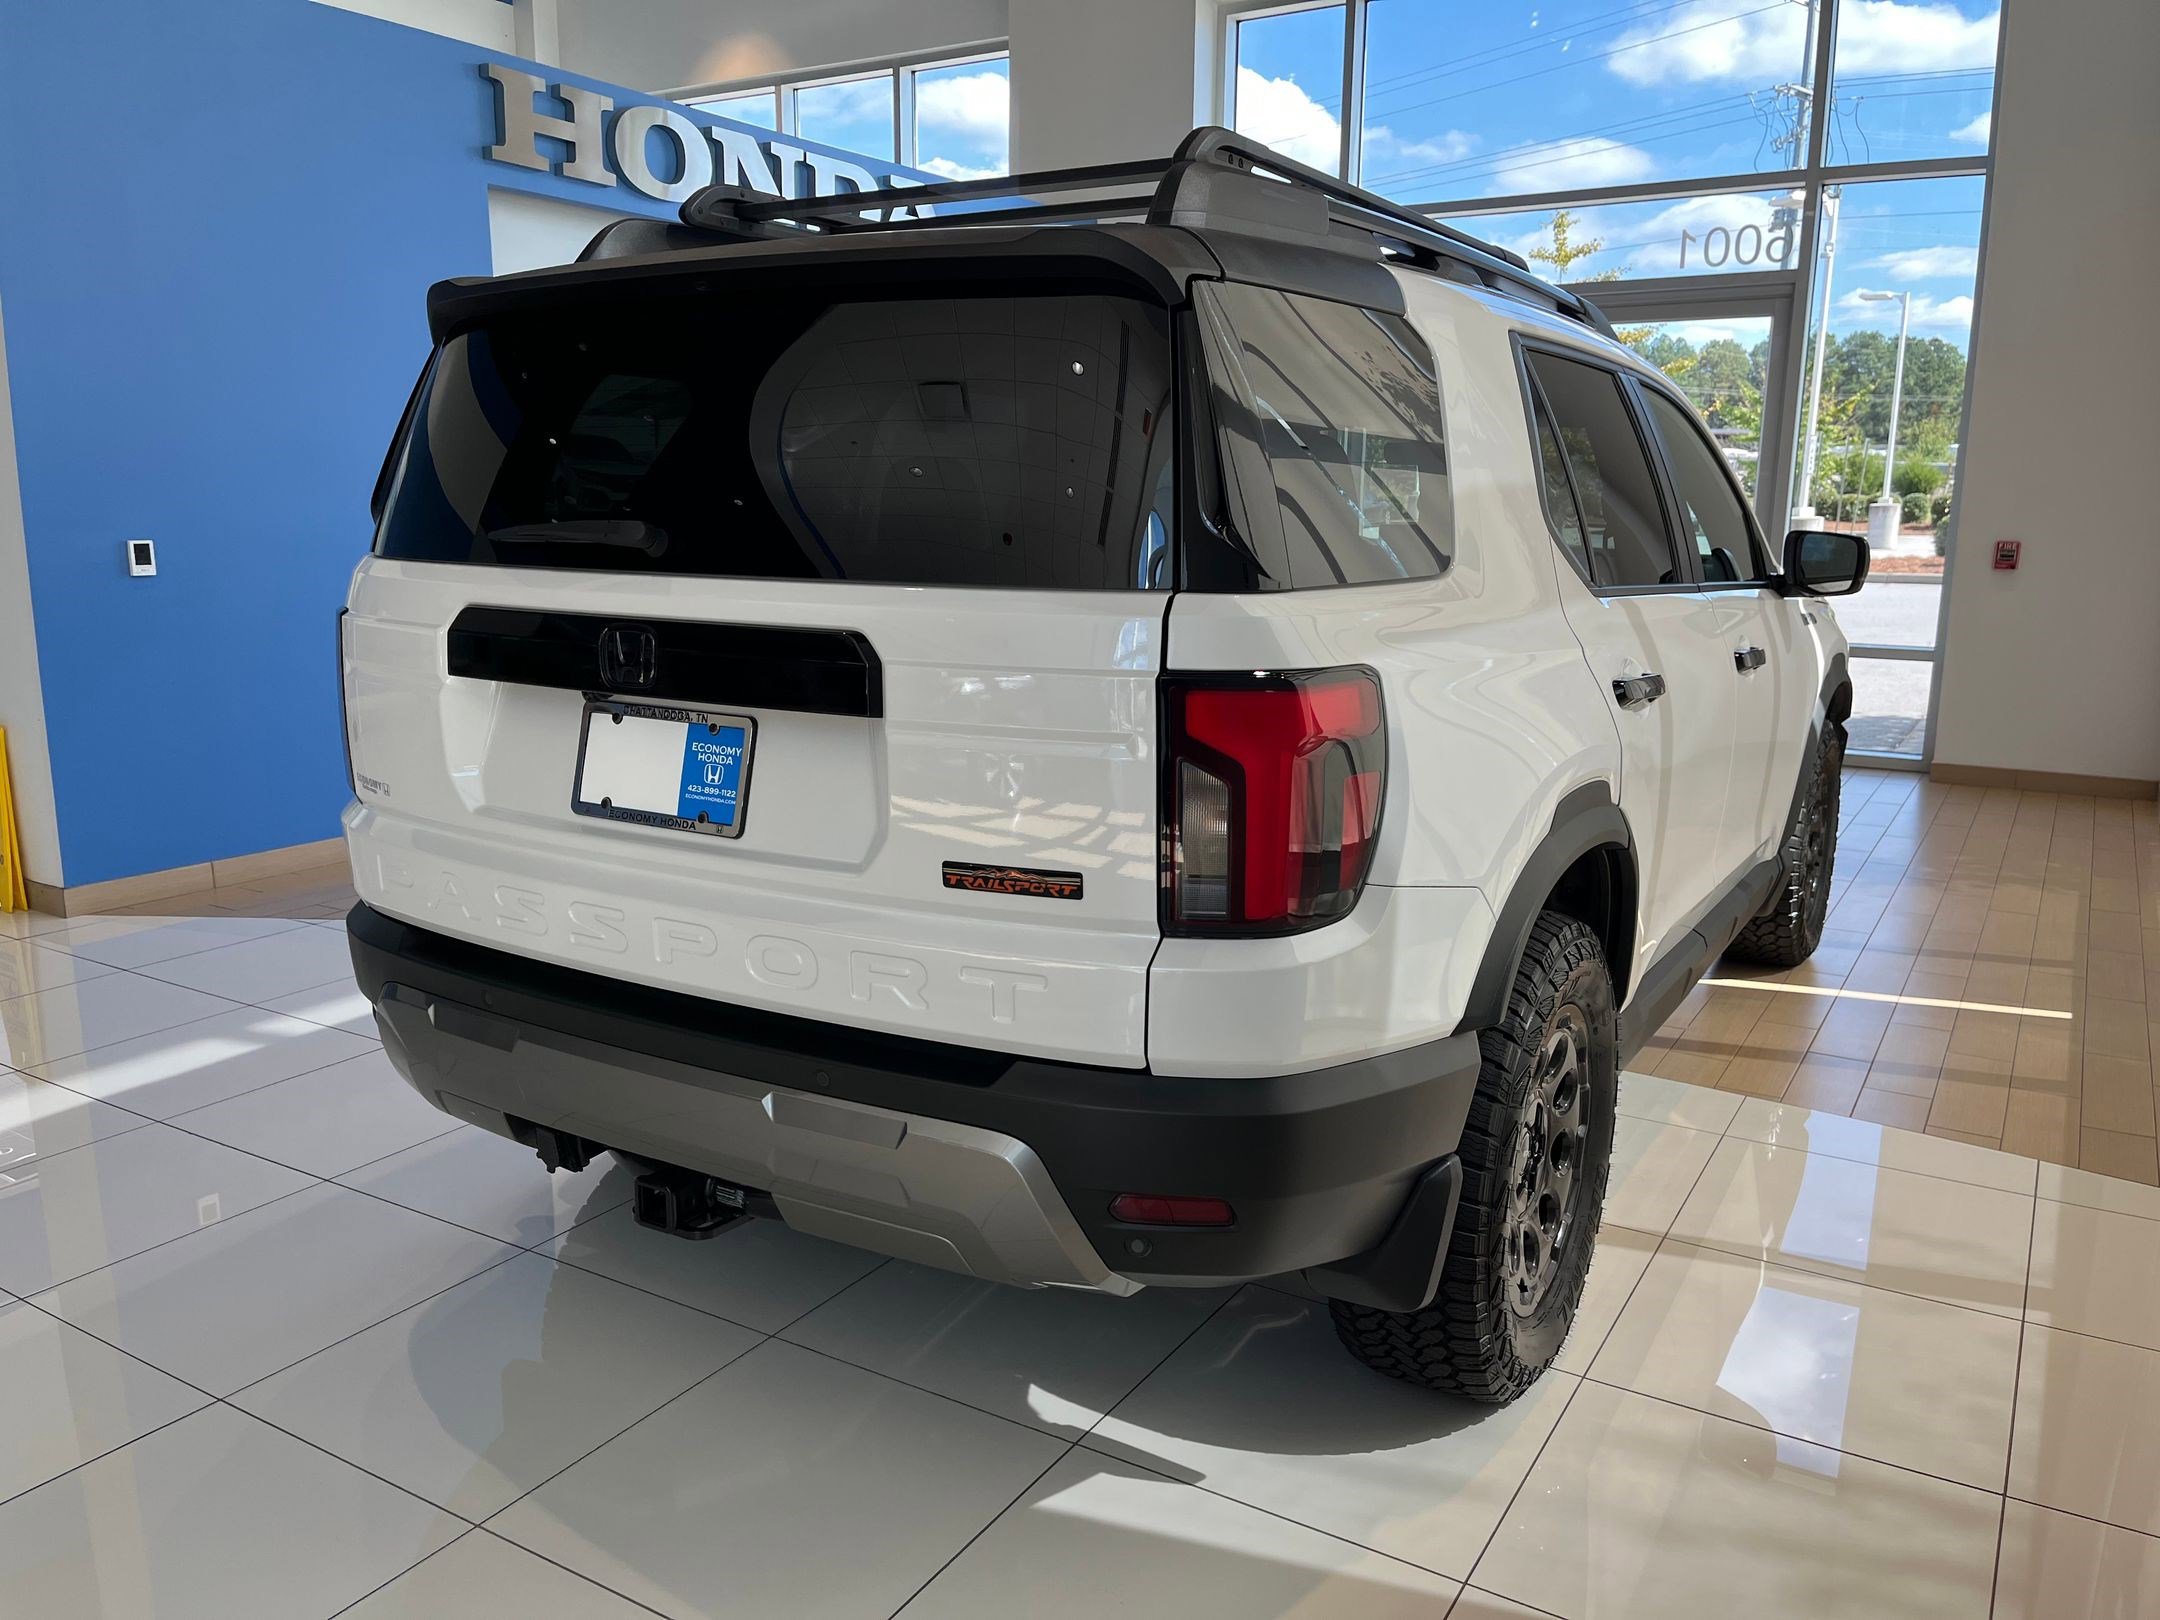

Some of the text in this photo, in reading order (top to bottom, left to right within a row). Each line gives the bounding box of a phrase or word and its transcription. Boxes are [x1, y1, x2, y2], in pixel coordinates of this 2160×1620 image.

[696, 713, 709, 723] TN
[692, 742, 742, 757] ECONOMY
[697, 753, 733, 765] HONDA
[687, 784, 736, 798] 423-899-1122
[608, 809, 697, 831] ECONOMY HONDA
[945, 874, 1078, 897] TRAILSPORT
[376, 853, 1050, 1024] PASSPORT
